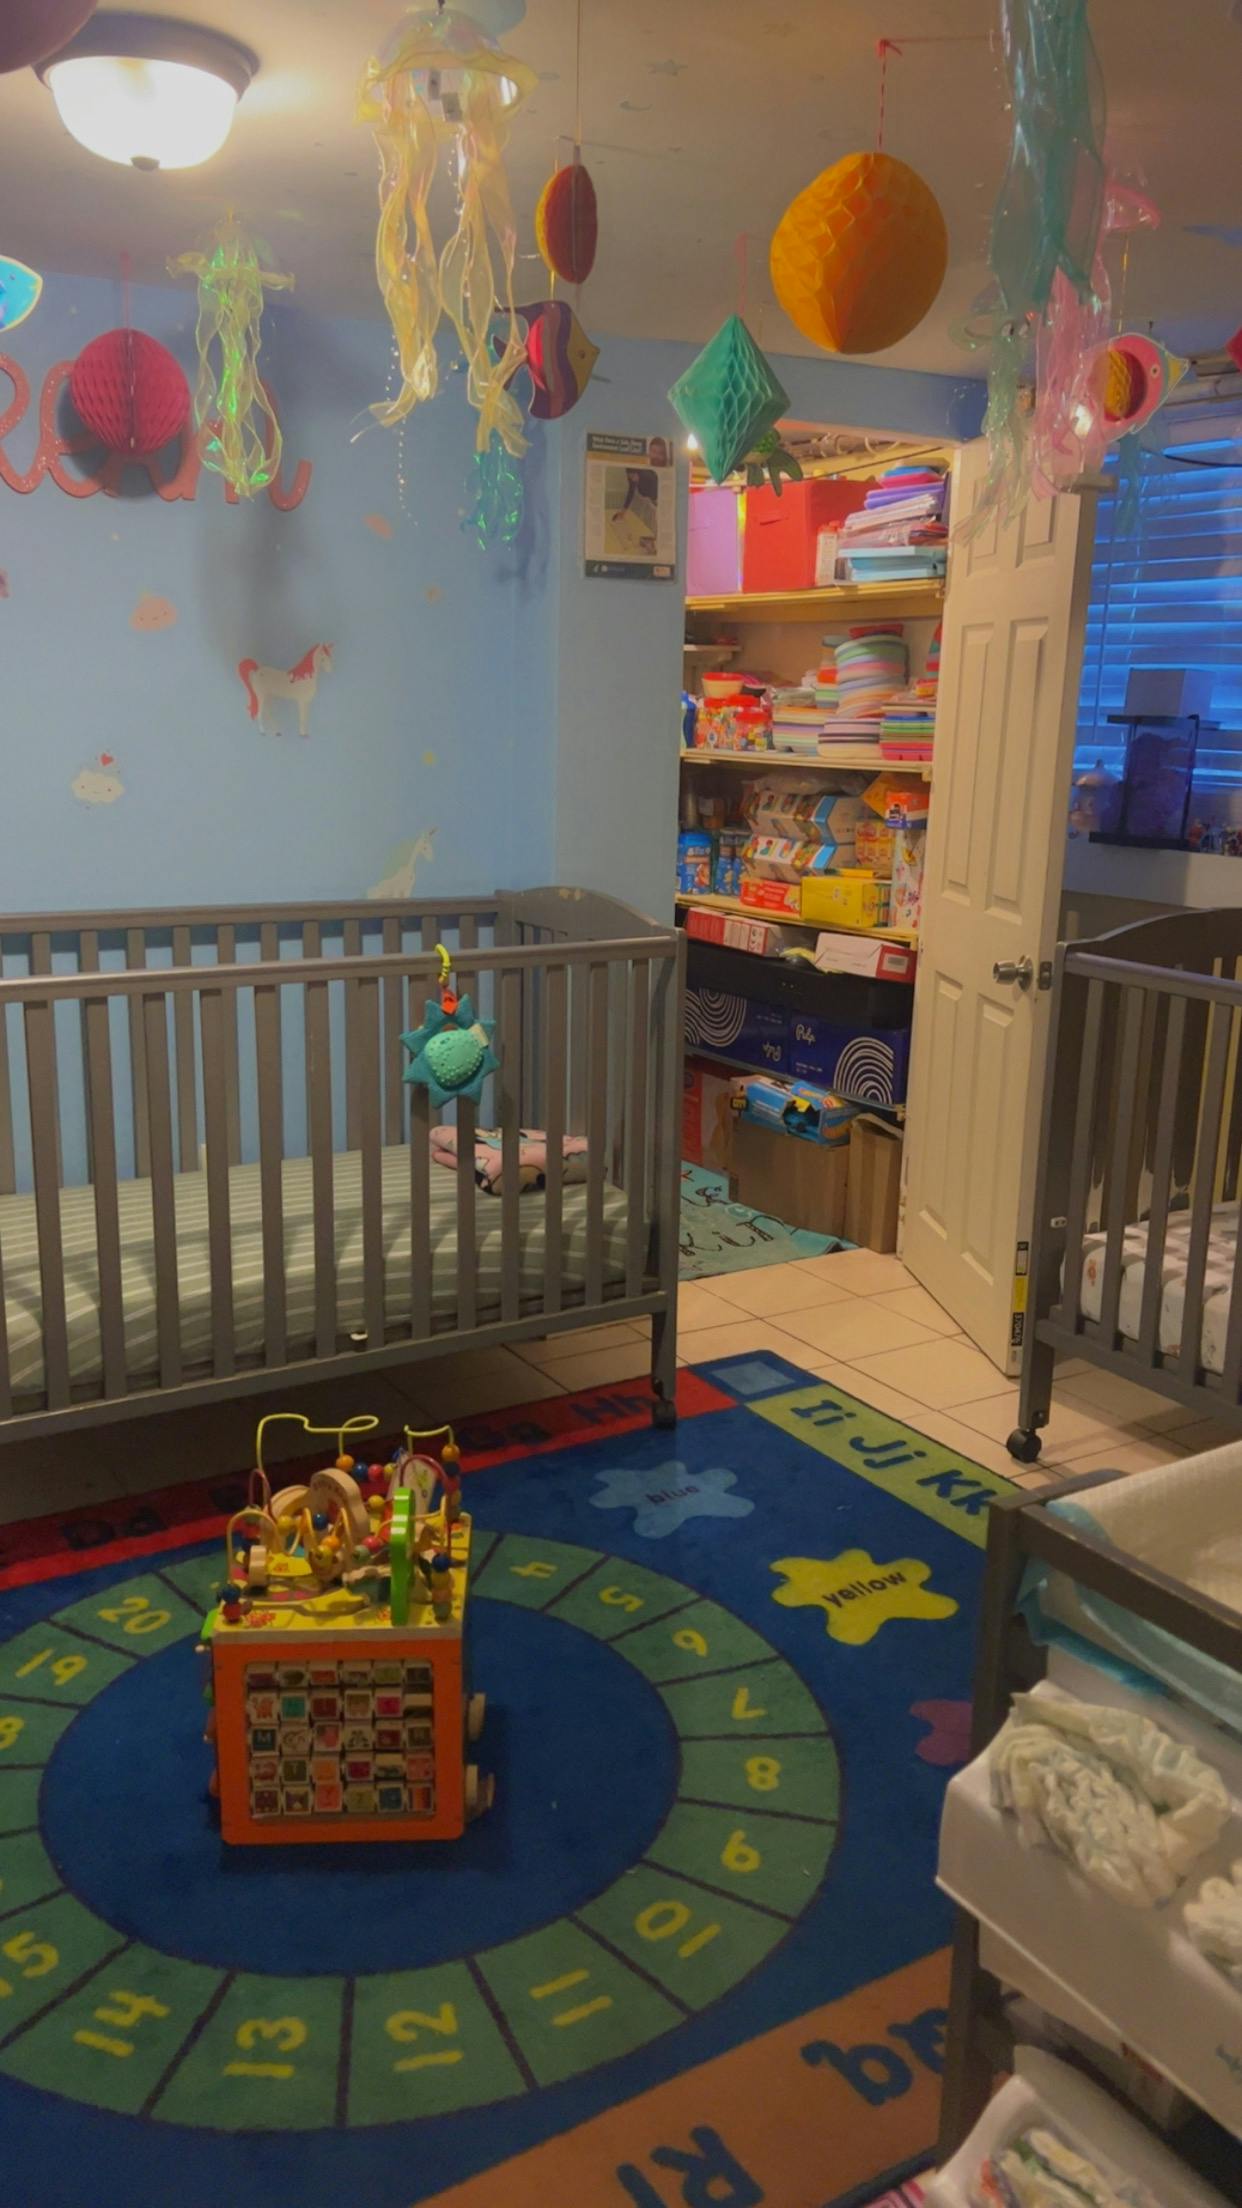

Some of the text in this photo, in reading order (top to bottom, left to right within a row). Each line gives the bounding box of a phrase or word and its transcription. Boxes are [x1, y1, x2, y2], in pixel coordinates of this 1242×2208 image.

[790, 1399, 998, 1516] Ii Jj Kk
[645, 1484, 700, 1506] blue
[510, 1561, 558, 1579] 4
[599, 1585, 644, 1613] 5
[823, 1571, 906, 1609] yellow
[99, 1595, 174, 1636] 20
[671, 1628, 709, 1658] 6
[15, 1648, 89, 1687] 19
[730, 1686, 769, 1721] 7
[0, 1715, 25, 1751] 8
[743, 1755, 783, 1794] 8
[721, 1829, 764, 1875] 9
[634, 1900, 723, 1960] 10
[529, 1968, 614, 2029] 11
[73, 1990, 170, 2058] 14
[385, 2002, 466, 2072] 12
[224, 2016, 310, 2080] 13
